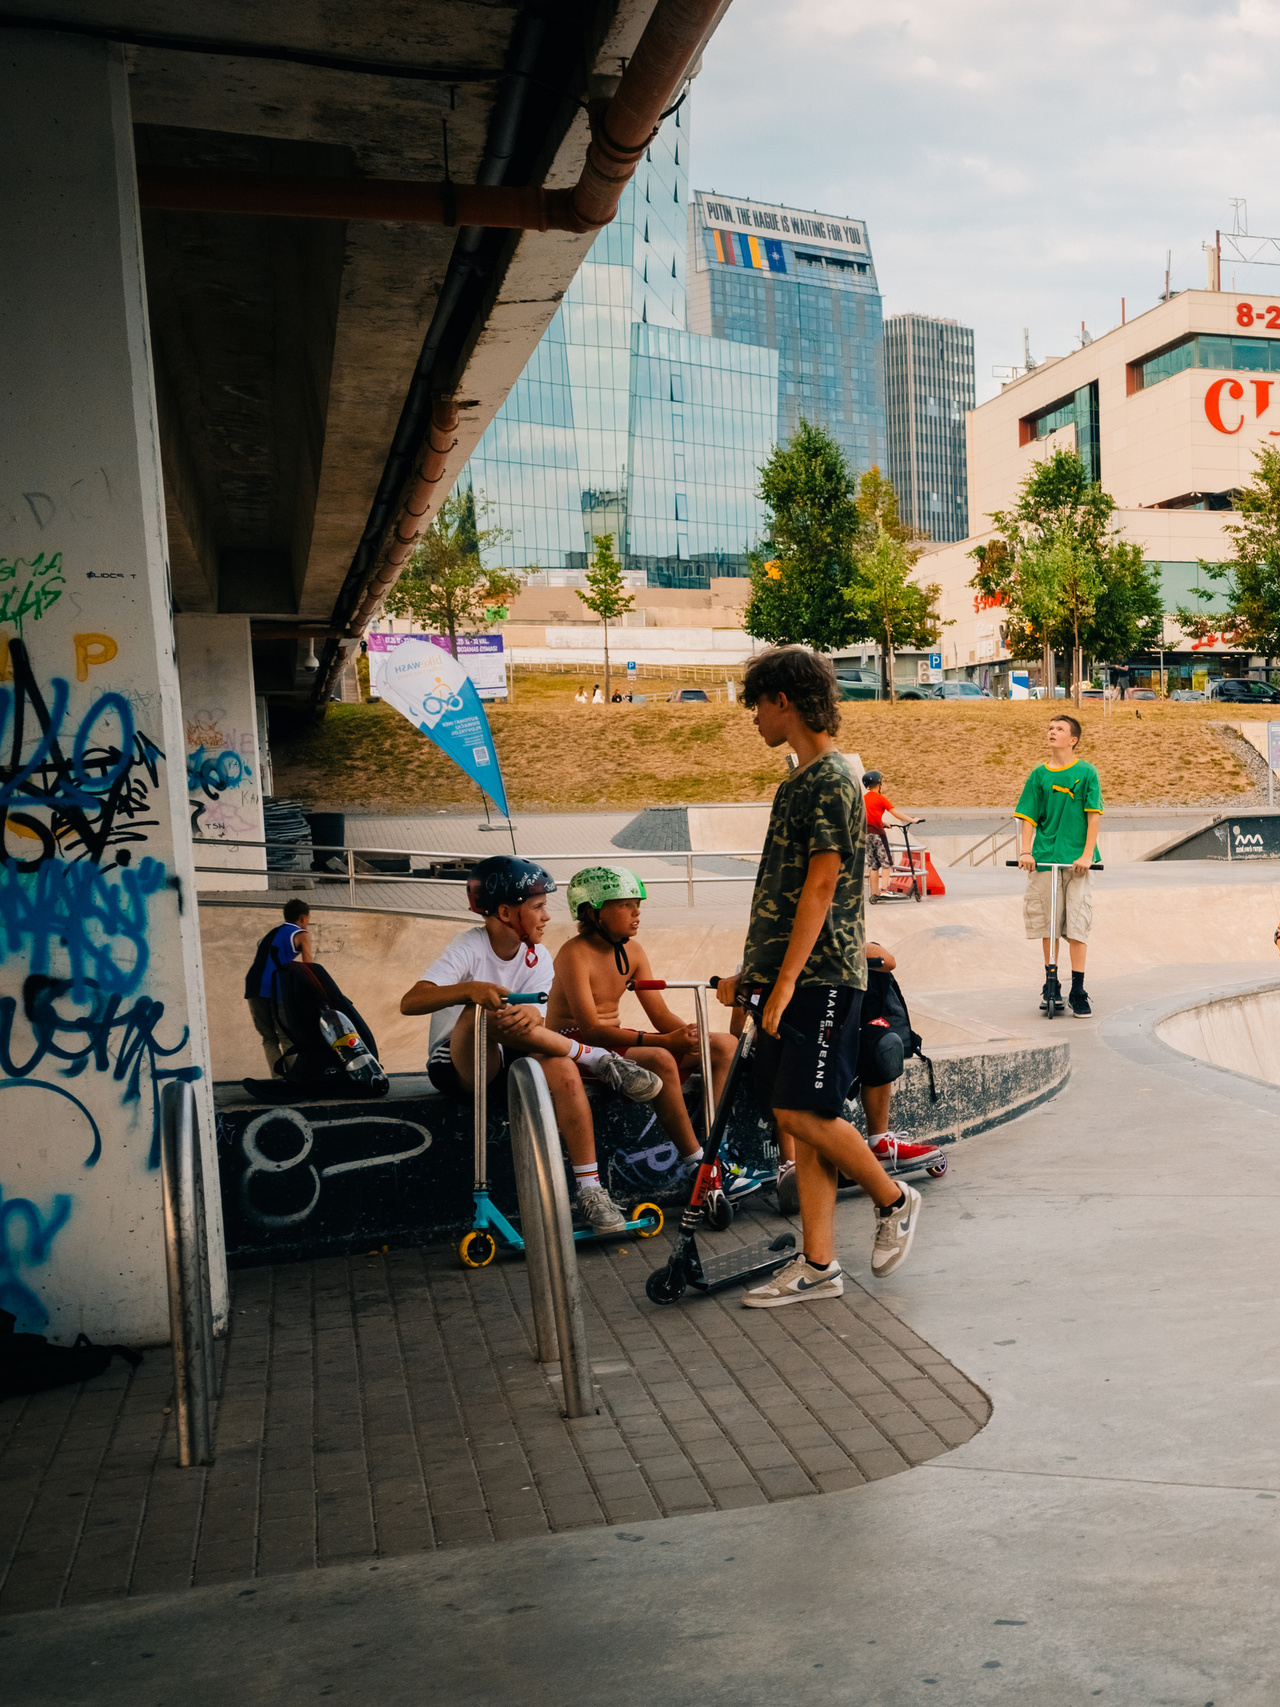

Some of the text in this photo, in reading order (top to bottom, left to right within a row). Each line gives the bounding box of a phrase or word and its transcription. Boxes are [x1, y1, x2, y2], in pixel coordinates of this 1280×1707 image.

[735, 206, 752, 227] THE
[752, 210, 780, 232] HAGUE
[780, 215, 790, 234] IS
[790, 216, 826, 239] WAITING
[827, 223, 843, 242] FOR
[843, 226, 861, 245] YOU
[814, 1041, 830, 1089] JEANS
